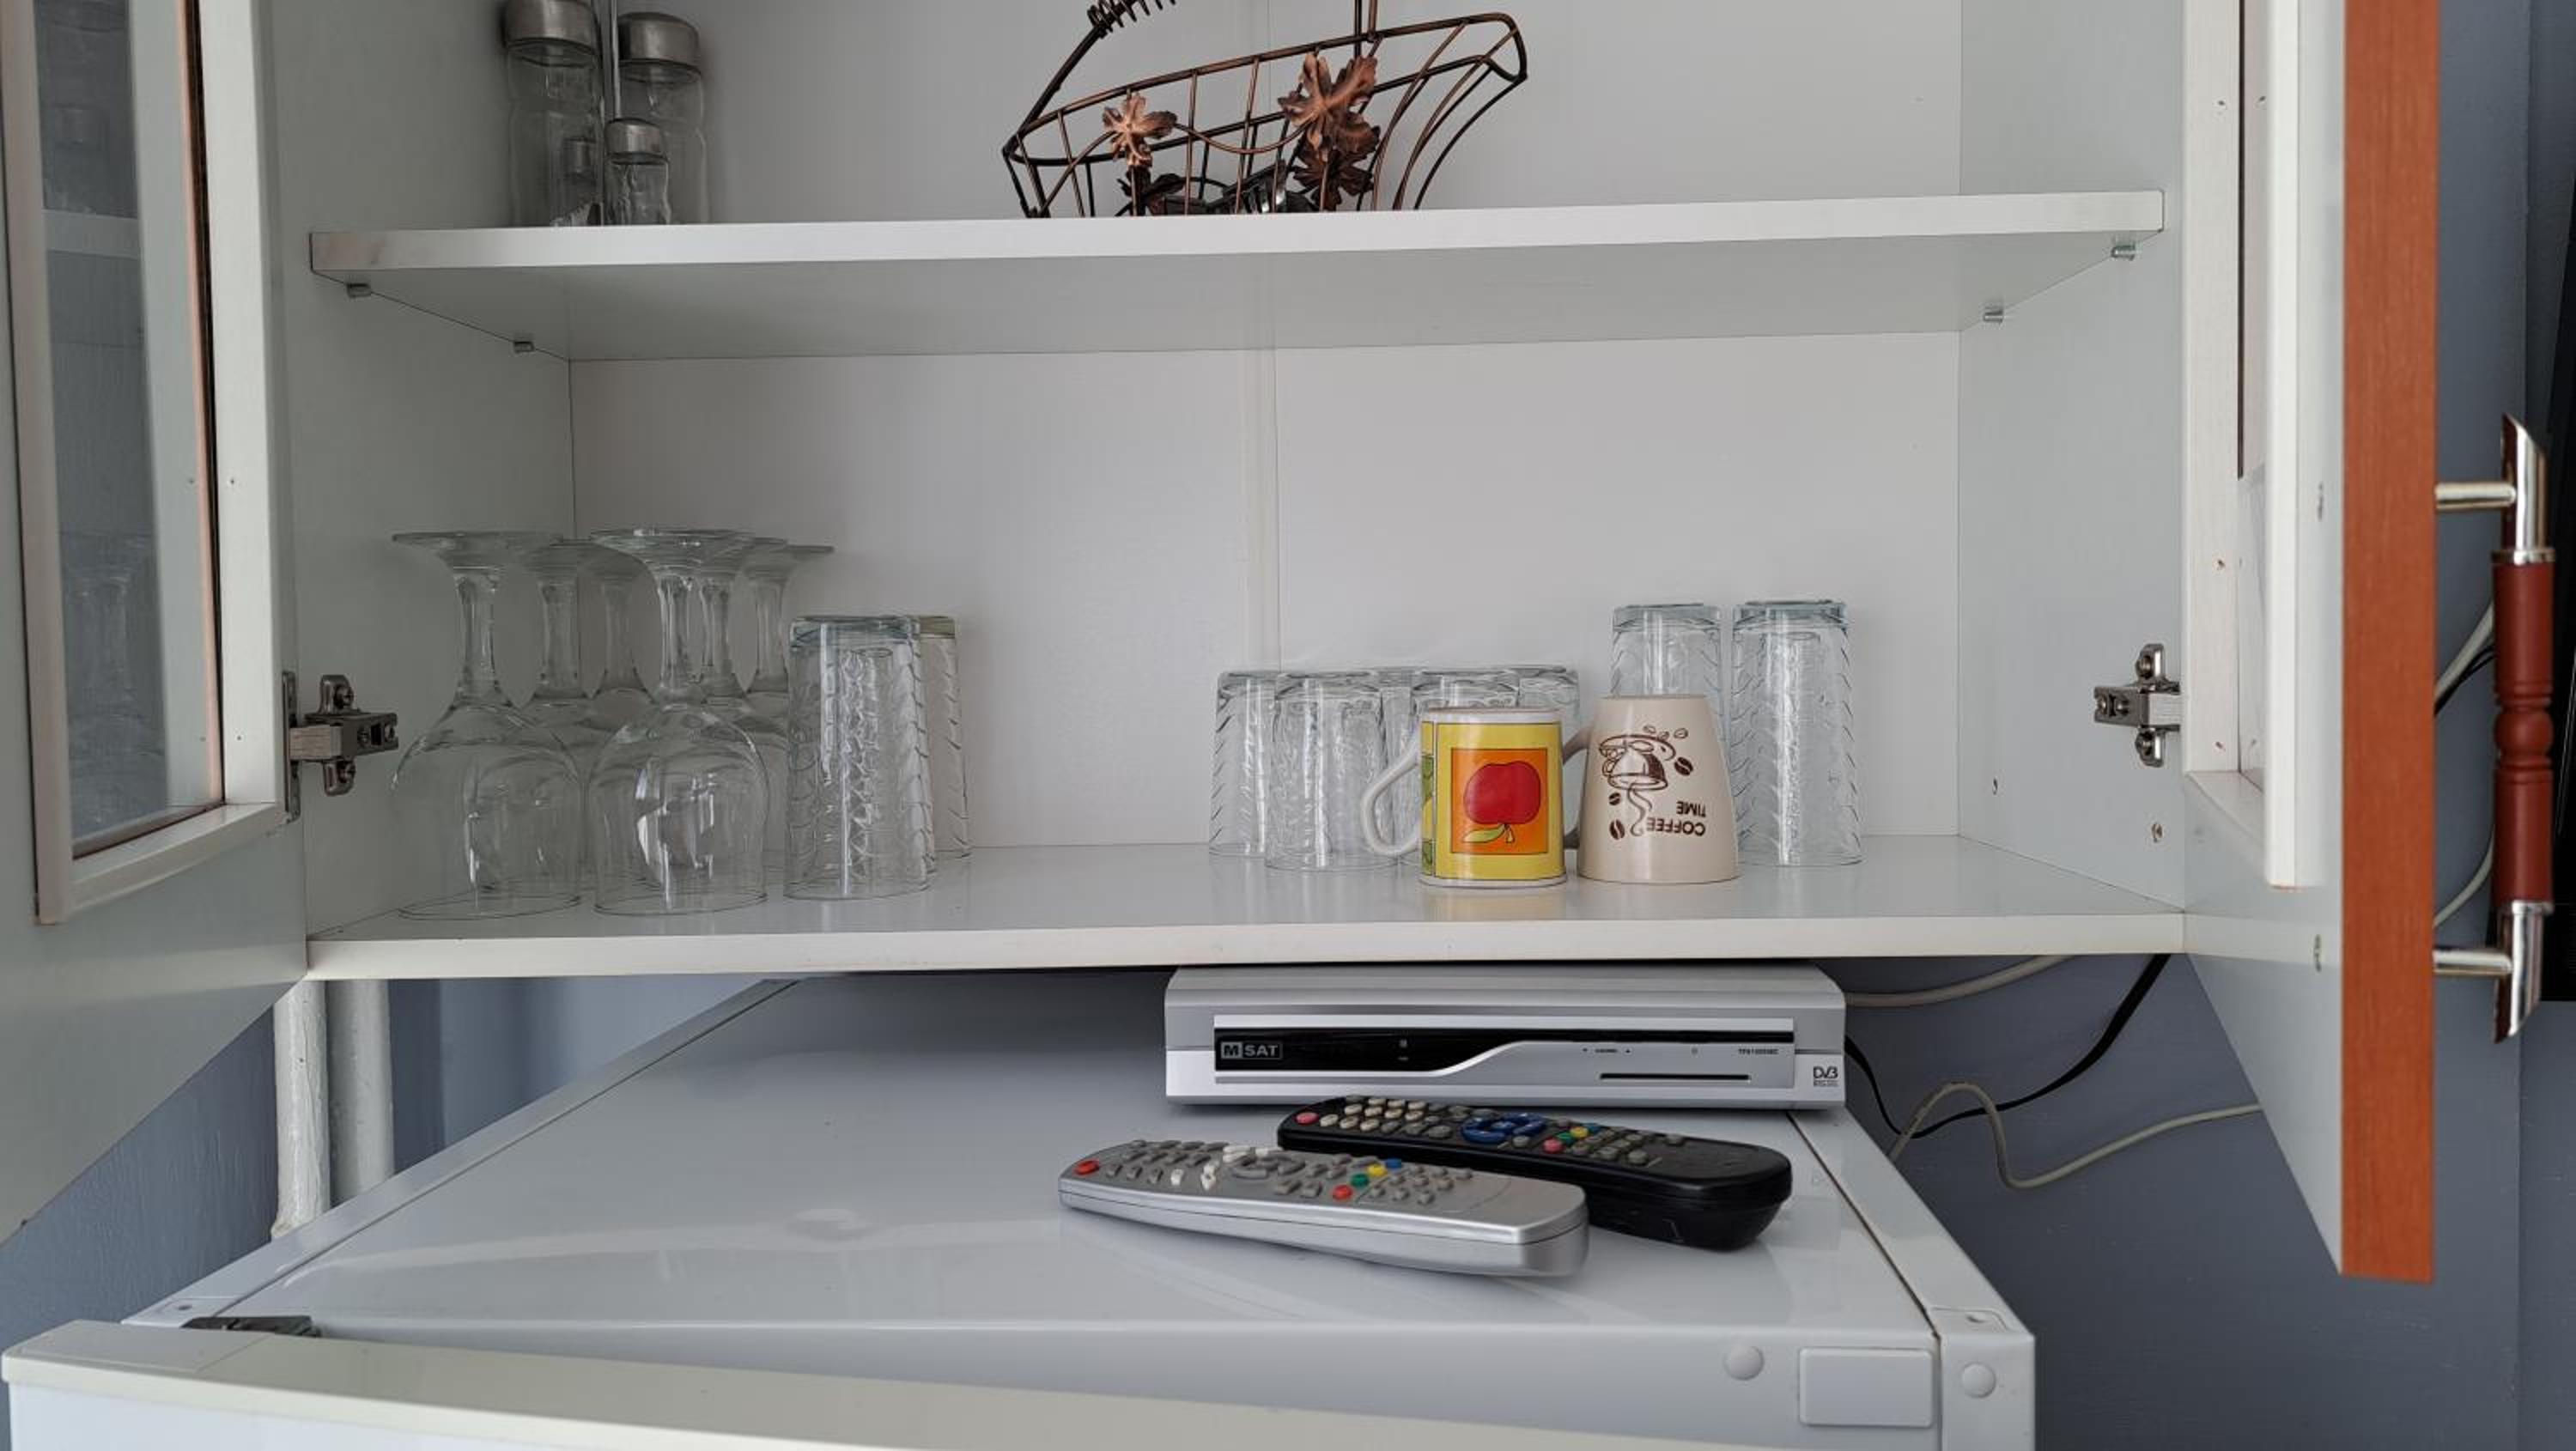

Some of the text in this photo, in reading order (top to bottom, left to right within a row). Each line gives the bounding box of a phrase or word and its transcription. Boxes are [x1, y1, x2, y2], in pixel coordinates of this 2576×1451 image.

[1676, 800, 1706, 817] TIME
[1646, 817, 1706, 837] COFFEE
[1243, 1044, 1279, 1057] SAT
